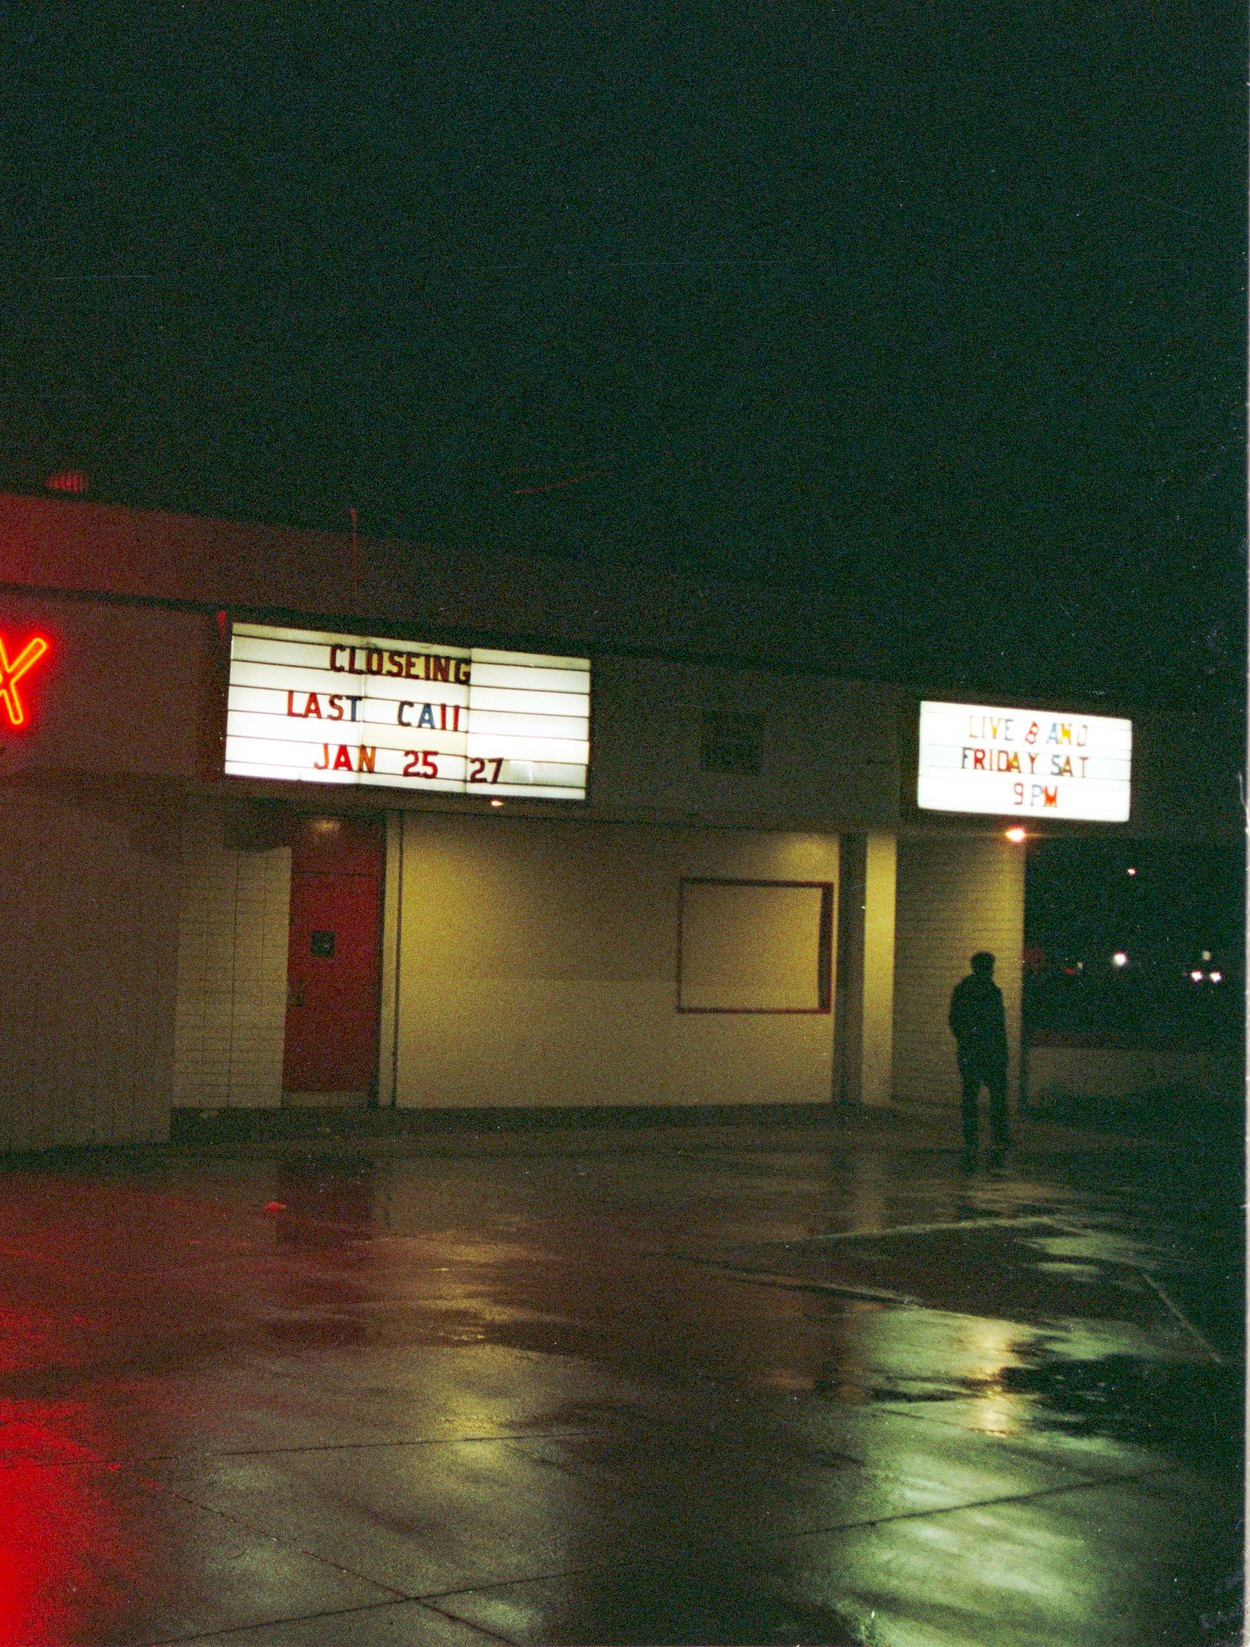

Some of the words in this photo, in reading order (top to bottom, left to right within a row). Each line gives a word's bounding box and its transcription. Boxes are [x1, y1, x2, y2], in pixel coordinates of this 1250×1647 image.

[329, 644, 472, 685] CLOSEING
[286, 690, 363, 723] LAST
[968, 716, 1014, 741] LIVE
[313, 744, 377, 773] JAN
[403, 750, 439, 780] 25
[469, 757, 504, 784] 27
[960, 746, 1039, 775] FRIDAY
[1050, 754, 1090, 779] SAT
